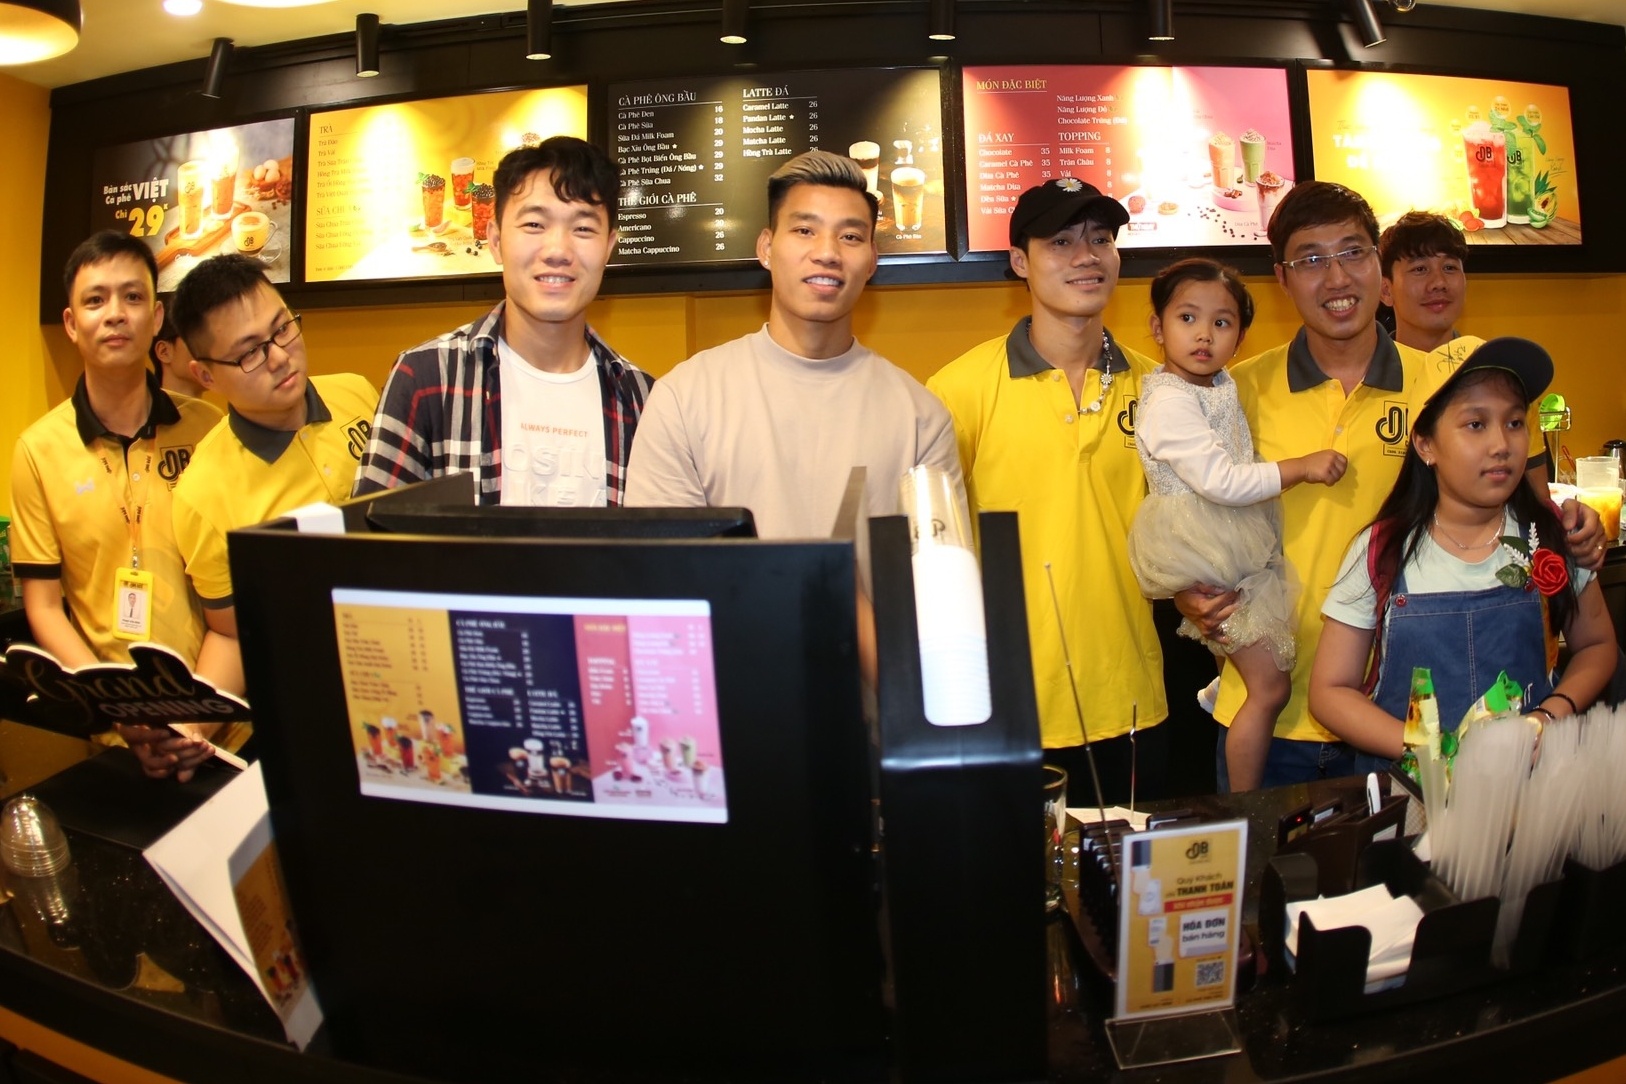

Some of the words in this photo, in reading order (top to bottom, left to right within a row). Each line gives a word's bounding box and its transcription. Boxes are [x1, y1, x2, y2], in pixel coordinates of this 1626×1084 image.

[976, 78, 1000, 91] MÓN
[1002, 78, 1023, 91] ĐẶC
[1024, 77, 1047, 90] BIỆT
[743, 87, 773, 98] LATTE
[775, 84, 789, 96] ĐÁ
[619, 94, 631, 106] CÀ
[633, 93, 652, 105] PHÊ
[654, 92, 675, 103] ÔNG
[677, 89, 697, 102] BẦU
[1096, 94, 1114, 102] Xanh
[742, 103, 771, 112] Caramel
[771, 102, 789, 110] Latte
[808, 100, 818, 108] 26
[743, 115, 768, 123] Pandan
[1057, 117, 1091, 125] Chocolate
[320, 123, 333, 134] TRÀ
[641, 132, 655, 140] Milk
[714, 128, 724, 136] 20
[742, 126, 765, 134] Mocha
[766, 125, 784, 133] Latte
[809, 123, 818, 131] 26
[742, 137, 768, 146] Matcha
[809, 135, 819, 143] 26
[978, 131, 993, 144] ĐÁ
[995, 133, 1015, 143] XAY
[1058, 131, 1101, 141] TOPPING
[774, 148, 792, 156] Latte
[978, 148, 1013, 157] Chocolate
[1040, 147, 1050, 155] 35
[979, 160, 1008, 168] Caramel
[1041, 159, 1051, 167] 35
[1105, 158, 1112, 166] 8
[1041, 170, 1051, 178] 35
[1106, 169, 1112, 177] 8
[654, 177, 671, 185] Chua
[133, 177, 169, 203] VIỆT
[105, 195, 116, 205] Cà
[639, 193, 659, 205] GIỚI
[661, 192, 674, 204] CÀ
[677, 191, 697, 203] PHÊ
[618, 213, 647, 221] Espresso
[618, 224, 652, 232] Americano
[618, 236, 655, 245] Cappuccino
[715, 231, 725, 239] 26
[618, 247, 642, 255] Matcha
[642, 246, 680, 255] Cappuccino
[715, 243, 725, 251] 26
[520, 422, 550, 434] ALWAYS
[552, 427, 588, 438] PERFECT
[24, 655, 196, 724] Grand
[98, 698, 234, 718] OPENING
[1176, 885, 1207, 896] THANH
[1210, 880, 1234, 892] TOÁN
[1183, 920, 1202, 932] HÓA
[1205, 917, 1226, 929] ĐƠN
[1182, 933, 1200, 942] bán
[1201, 931, 1225, 940] hàng
